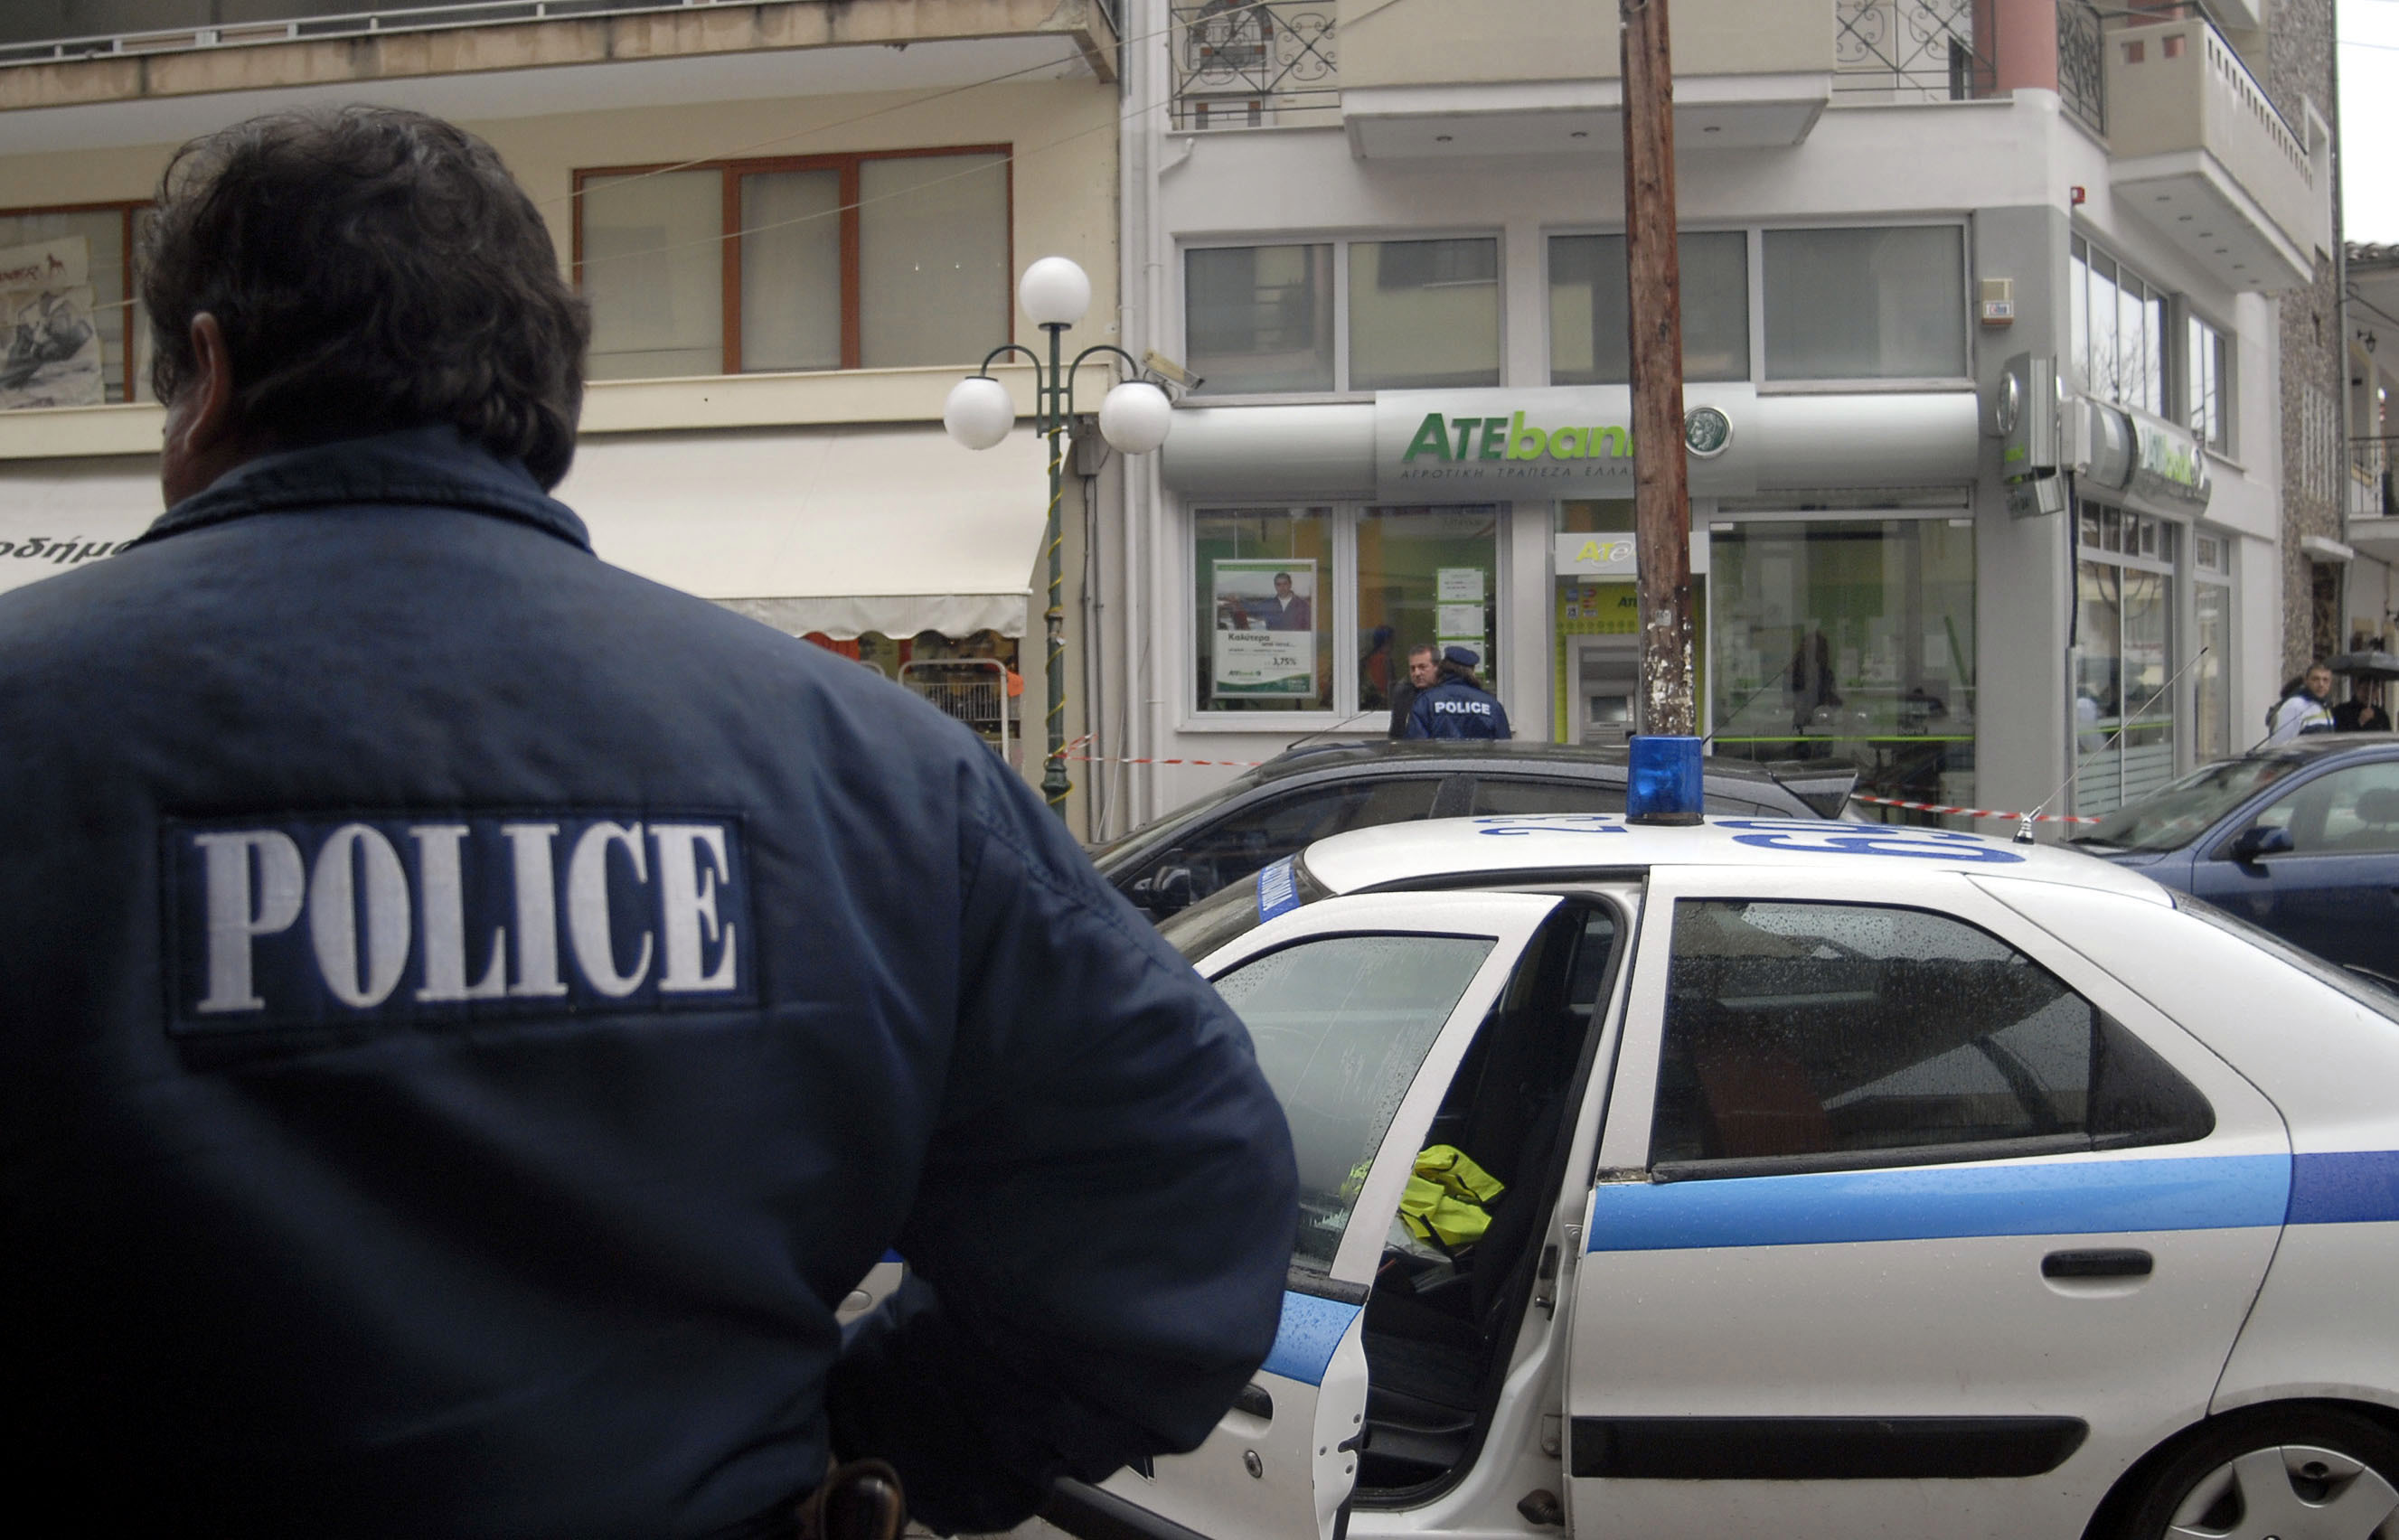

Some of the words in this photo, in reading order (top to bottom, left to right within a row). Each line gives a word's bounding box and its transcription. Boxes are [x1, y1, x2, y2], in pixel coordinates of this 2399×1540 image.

[1584, 465, 1628, 477] ΕΛΛΑ
[1435, 701, 1491, 716] POLICE
[193, 821, 737, 1013] POLICE
